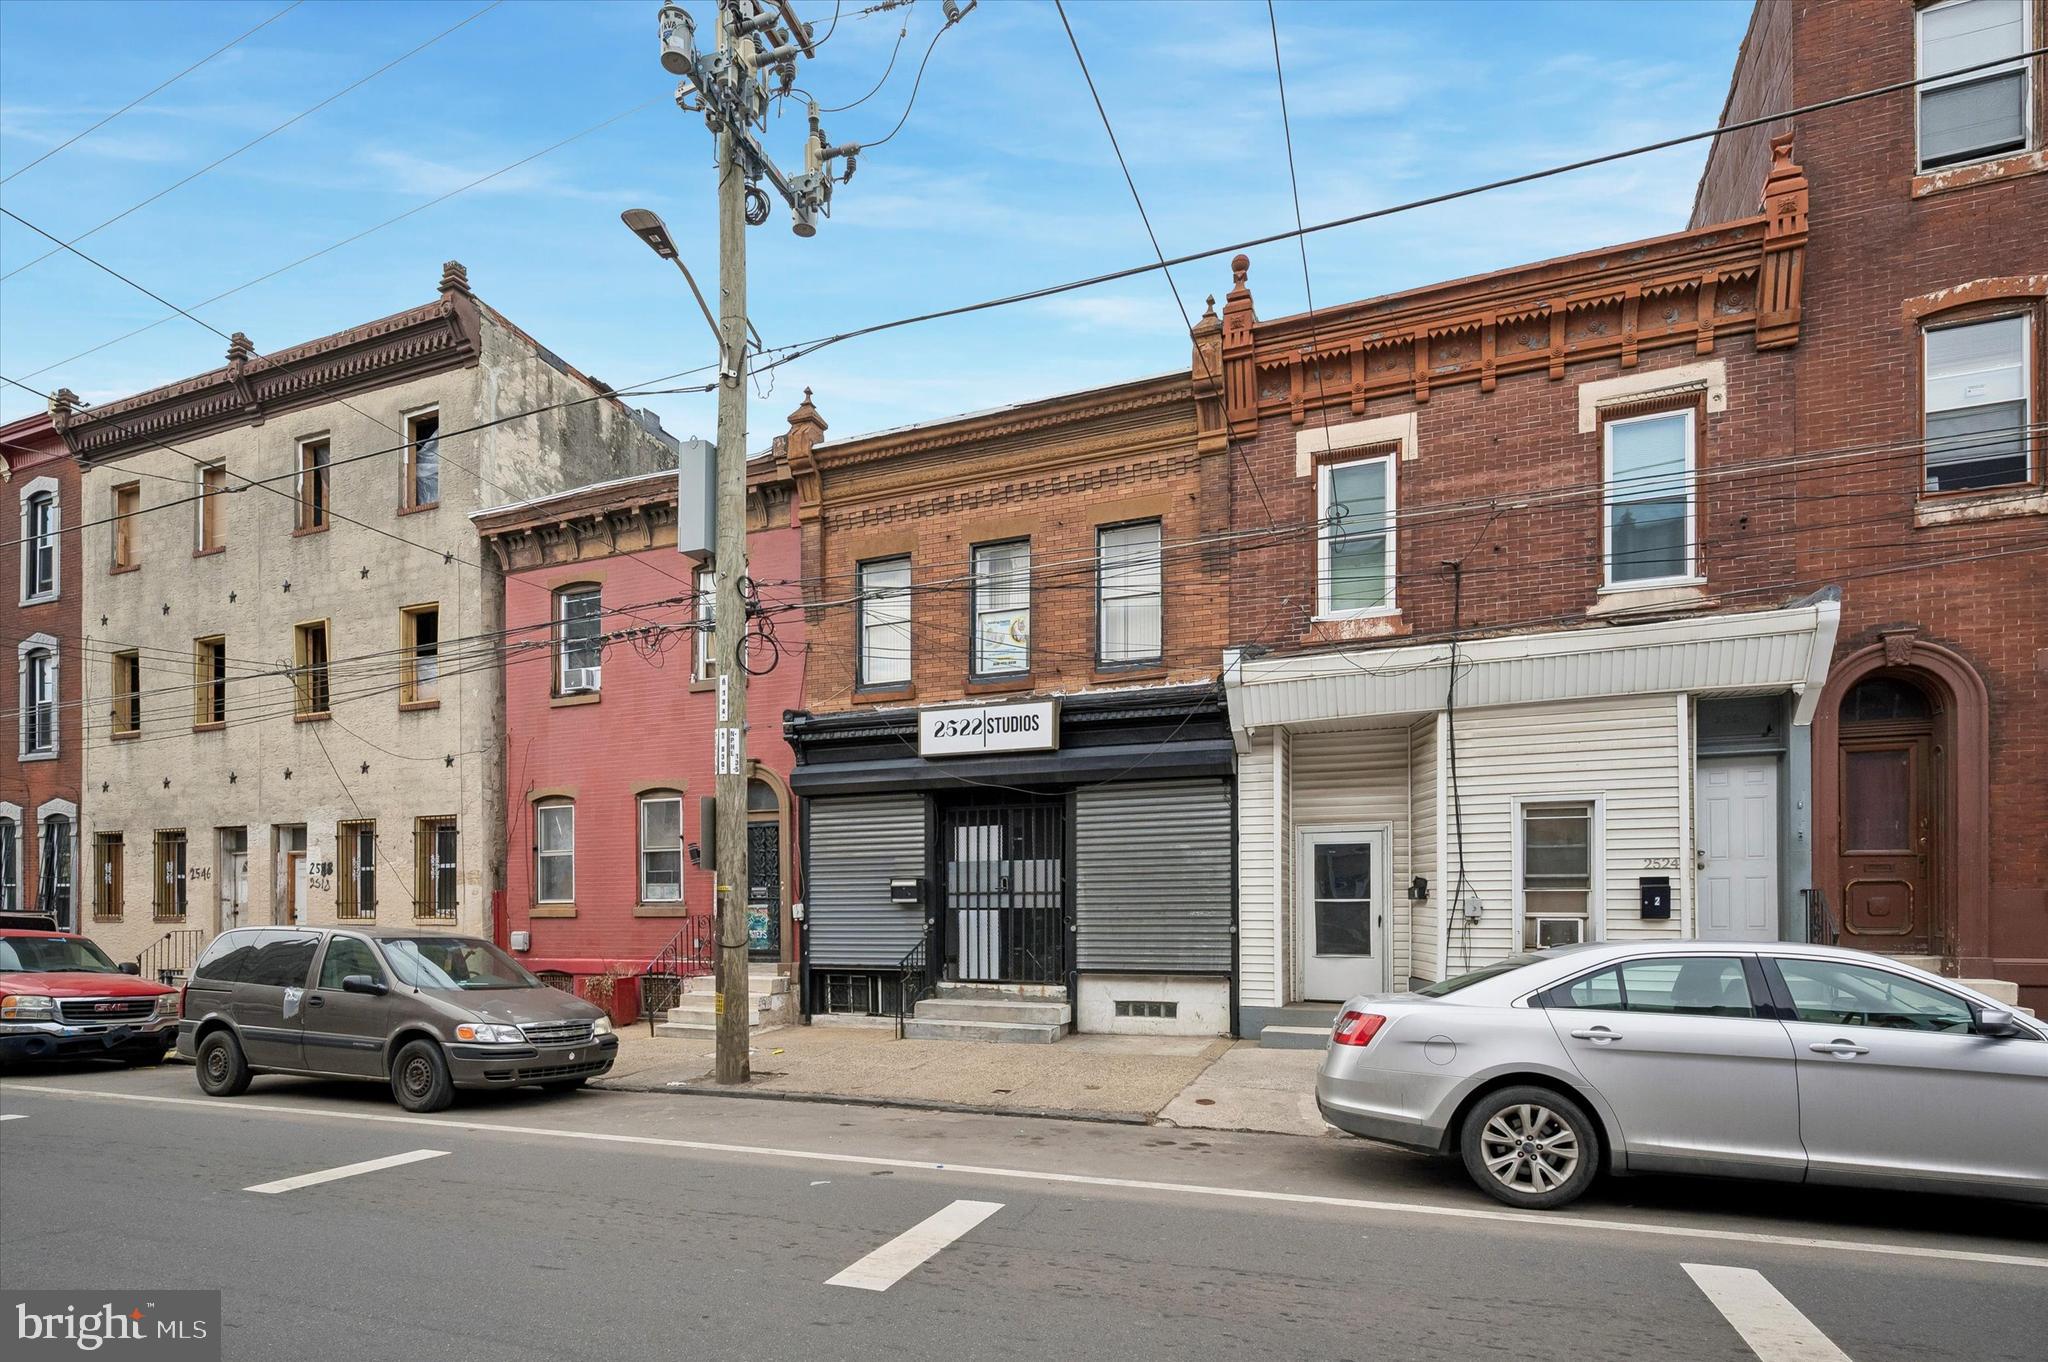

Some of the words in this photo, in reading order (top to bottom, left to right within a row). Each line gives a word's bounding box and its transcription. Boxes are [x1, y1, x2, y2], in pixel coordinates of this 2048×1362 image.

[934, 718, 983, 738] 2522
[987, 714, 1040, 734] STUDIOS
[1644, 858, 1680, 869] 2524
[1654, 896, 1661, 906] 2
[95, 1003, 128, 1012] GMC
